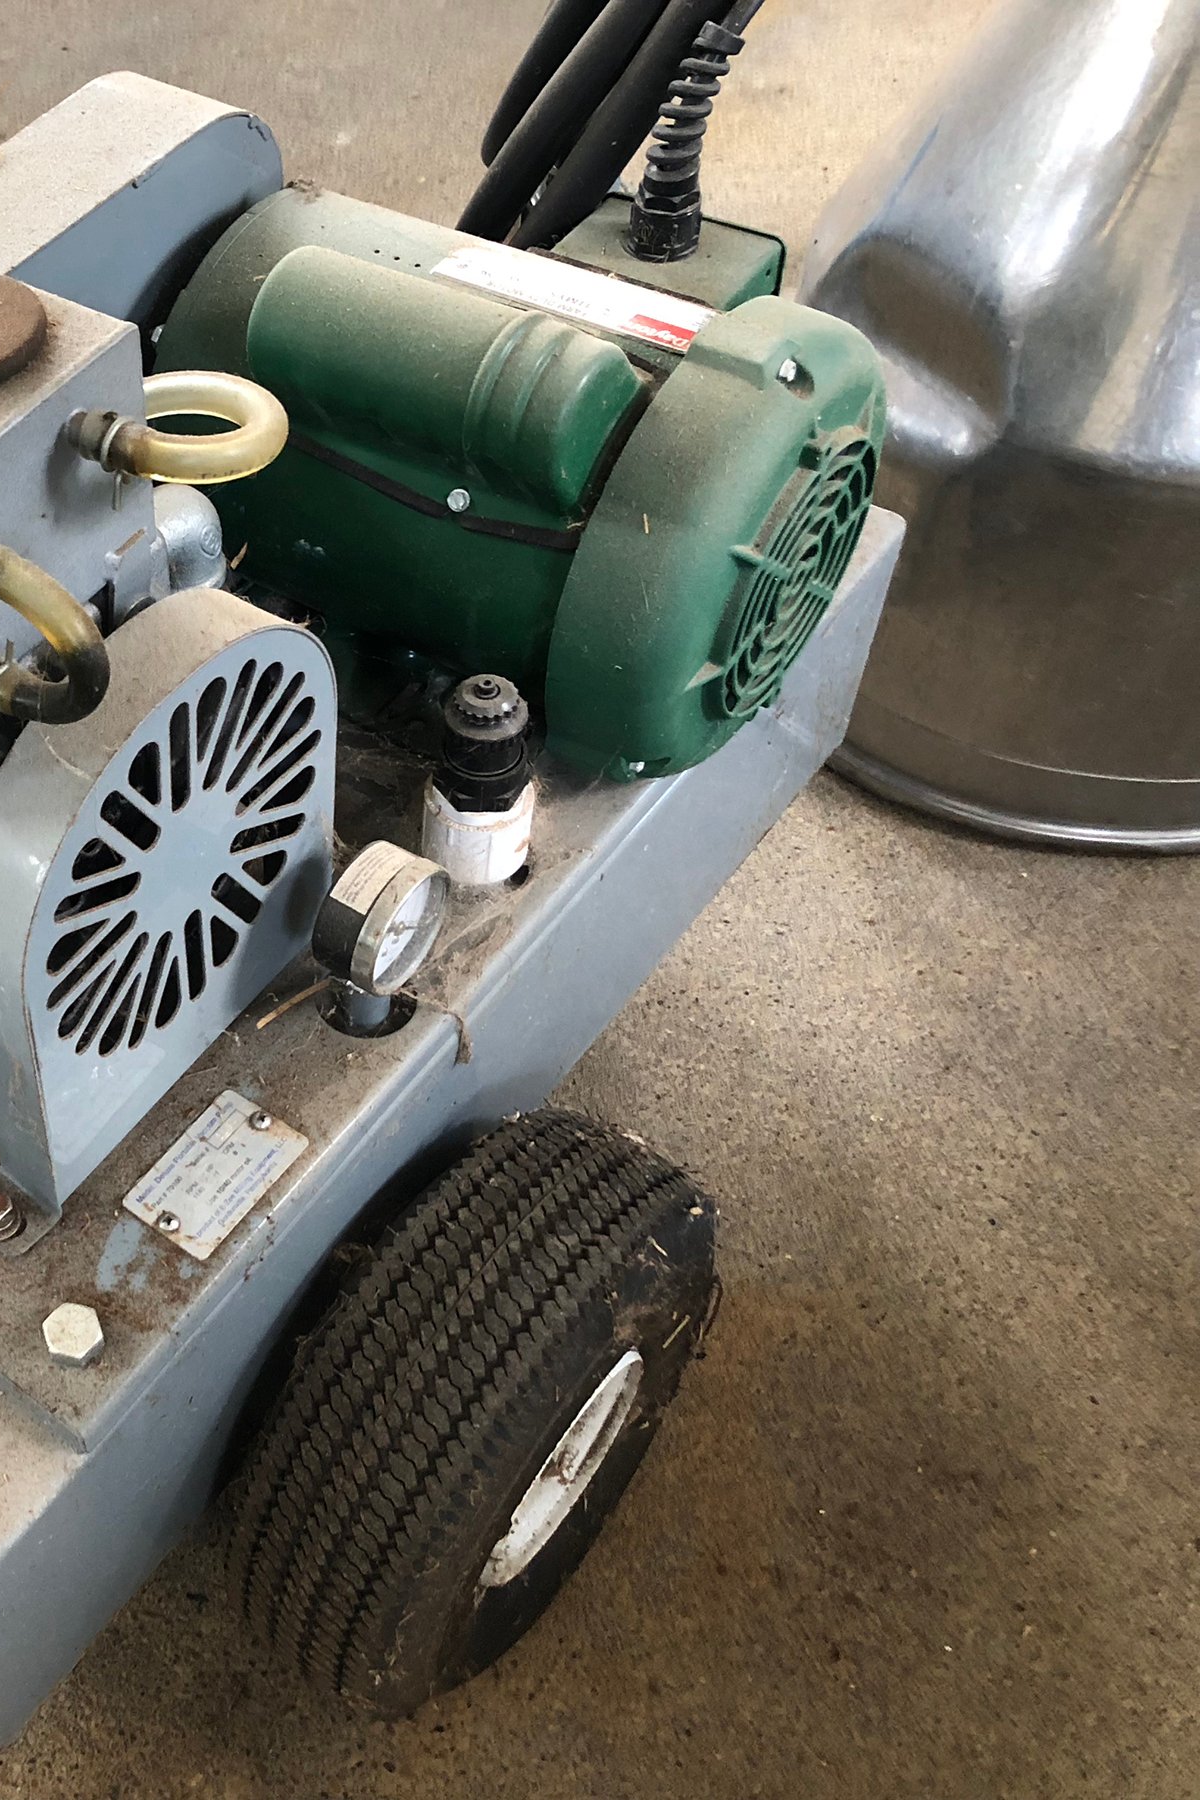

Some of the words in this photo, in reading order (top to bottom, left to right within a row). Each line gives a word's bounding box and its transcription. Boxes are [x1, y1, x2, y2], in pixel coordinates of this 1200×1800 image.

[620, 319, 691, 348] Dayton
[153, 1162, 175, 1184] Deluxe
[172, 1138, 196, 1164] Portable
